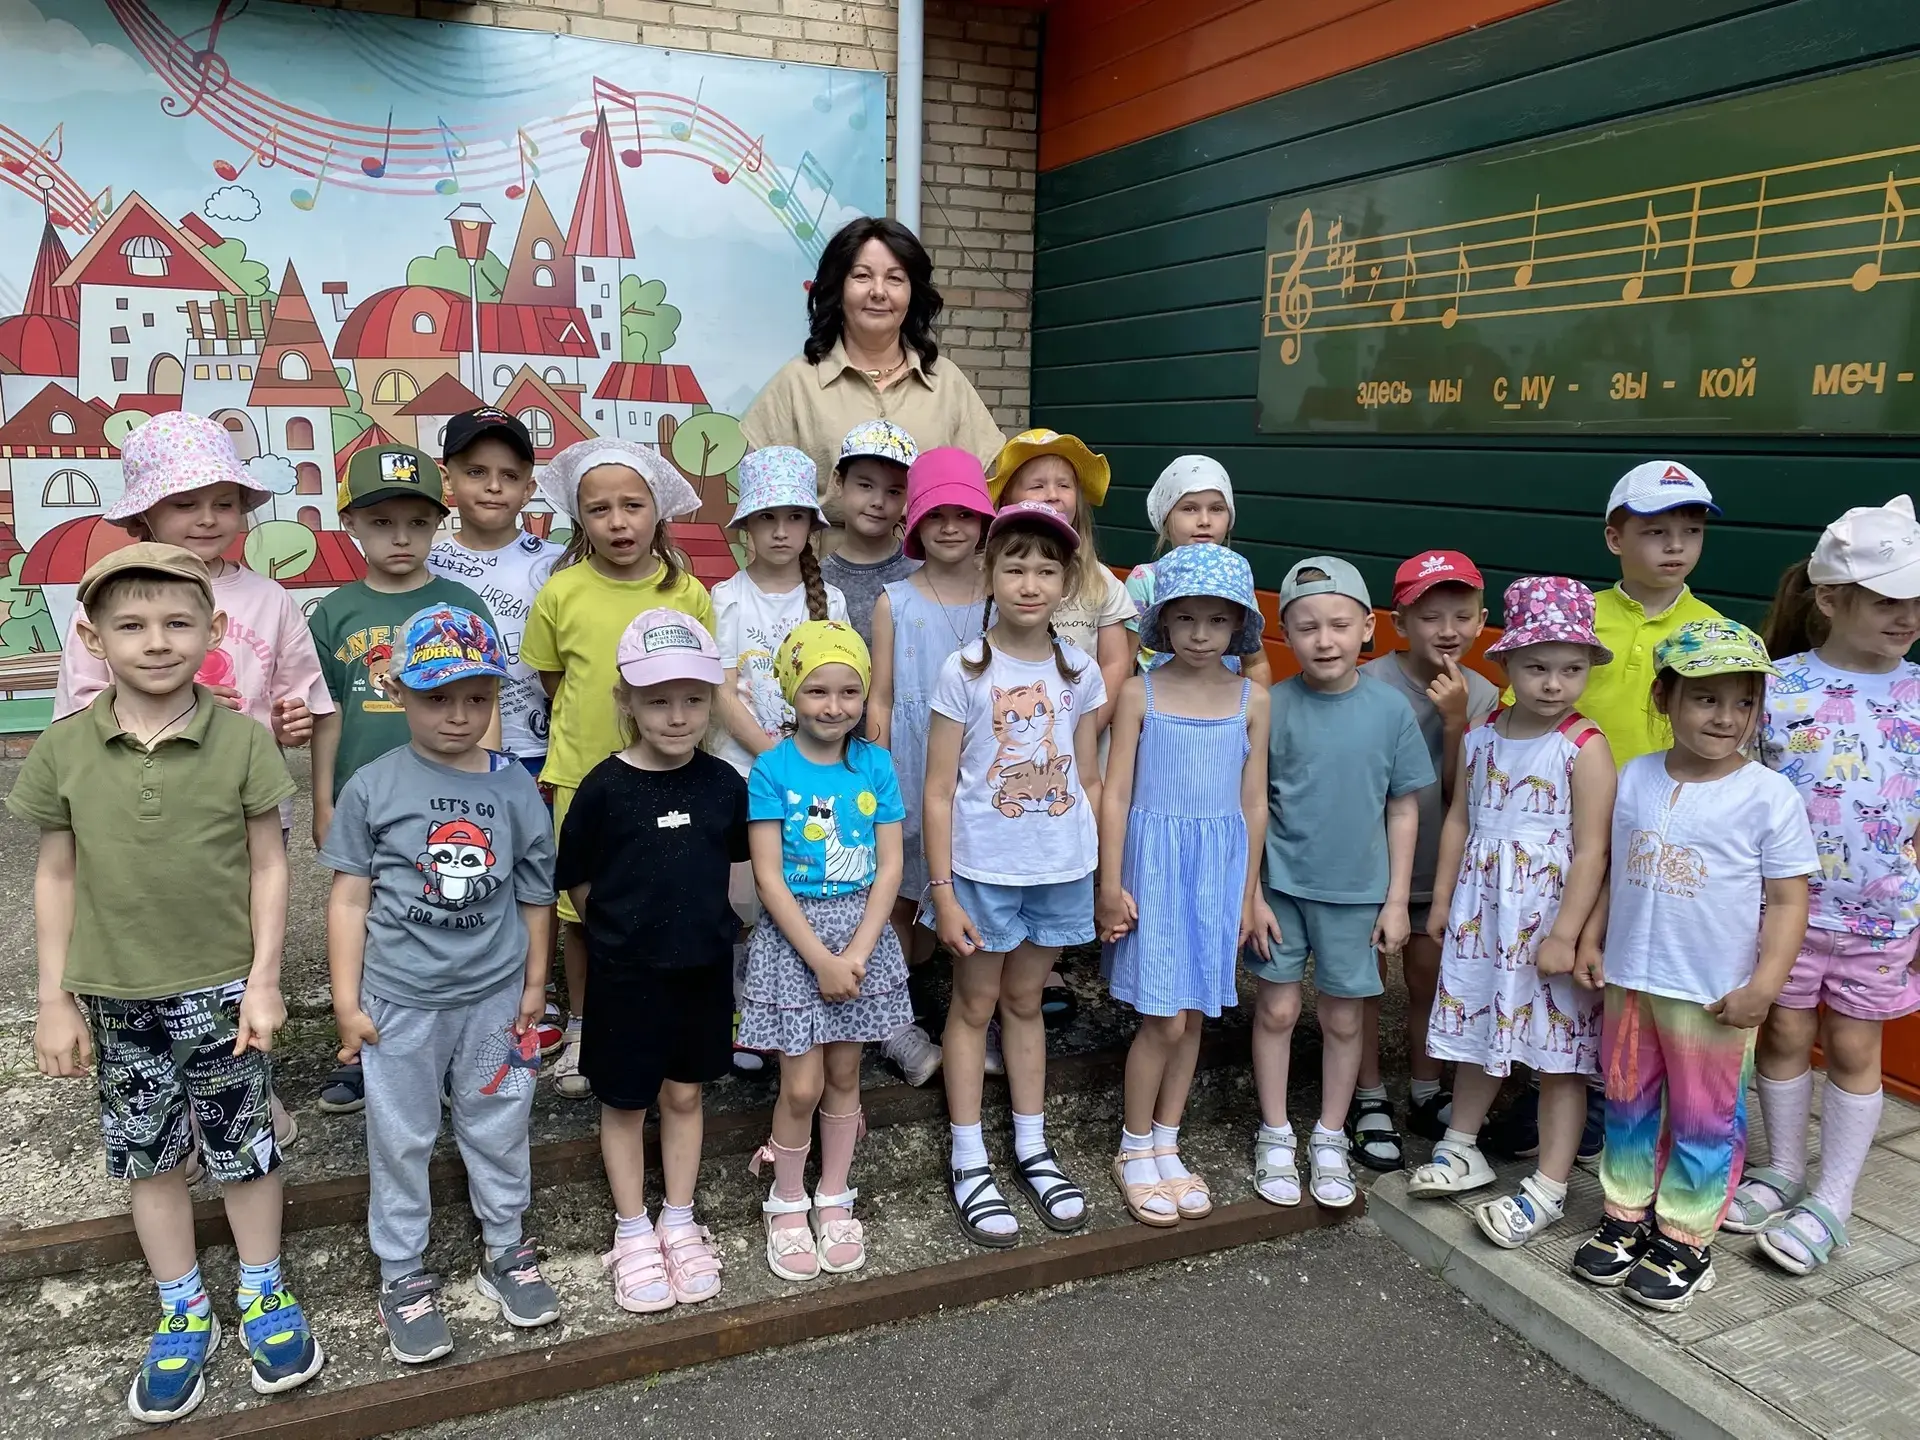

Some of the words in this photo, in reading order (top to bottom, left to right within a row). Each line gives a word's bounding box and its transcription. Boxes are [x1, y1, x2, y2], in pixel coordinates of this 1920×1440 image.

[1357, 380, 1413, 409] здесь
[1429, 378, 1463, 403] мы
[1609, 371, 1648, 400] зы
[1699, 356, 1757, 398] кой
[1811, 361, 1887, 396] меч
[1418, 562, 1455, 578] adidas
[430, 798, 470, 814] LET'S
[476, 803, 495, 818] GO
[1627, 878, 1695, 898] THAILAND
[407, 905, 433, 925] FOR
[440, 918, 448, 927] A
[455, 912, 486, 929] RIDE
[197, 1021, 217, 1035] KEY
[133, 1058, 156, 1070] KEY
[141, 1059, 172, 1079] RULES
